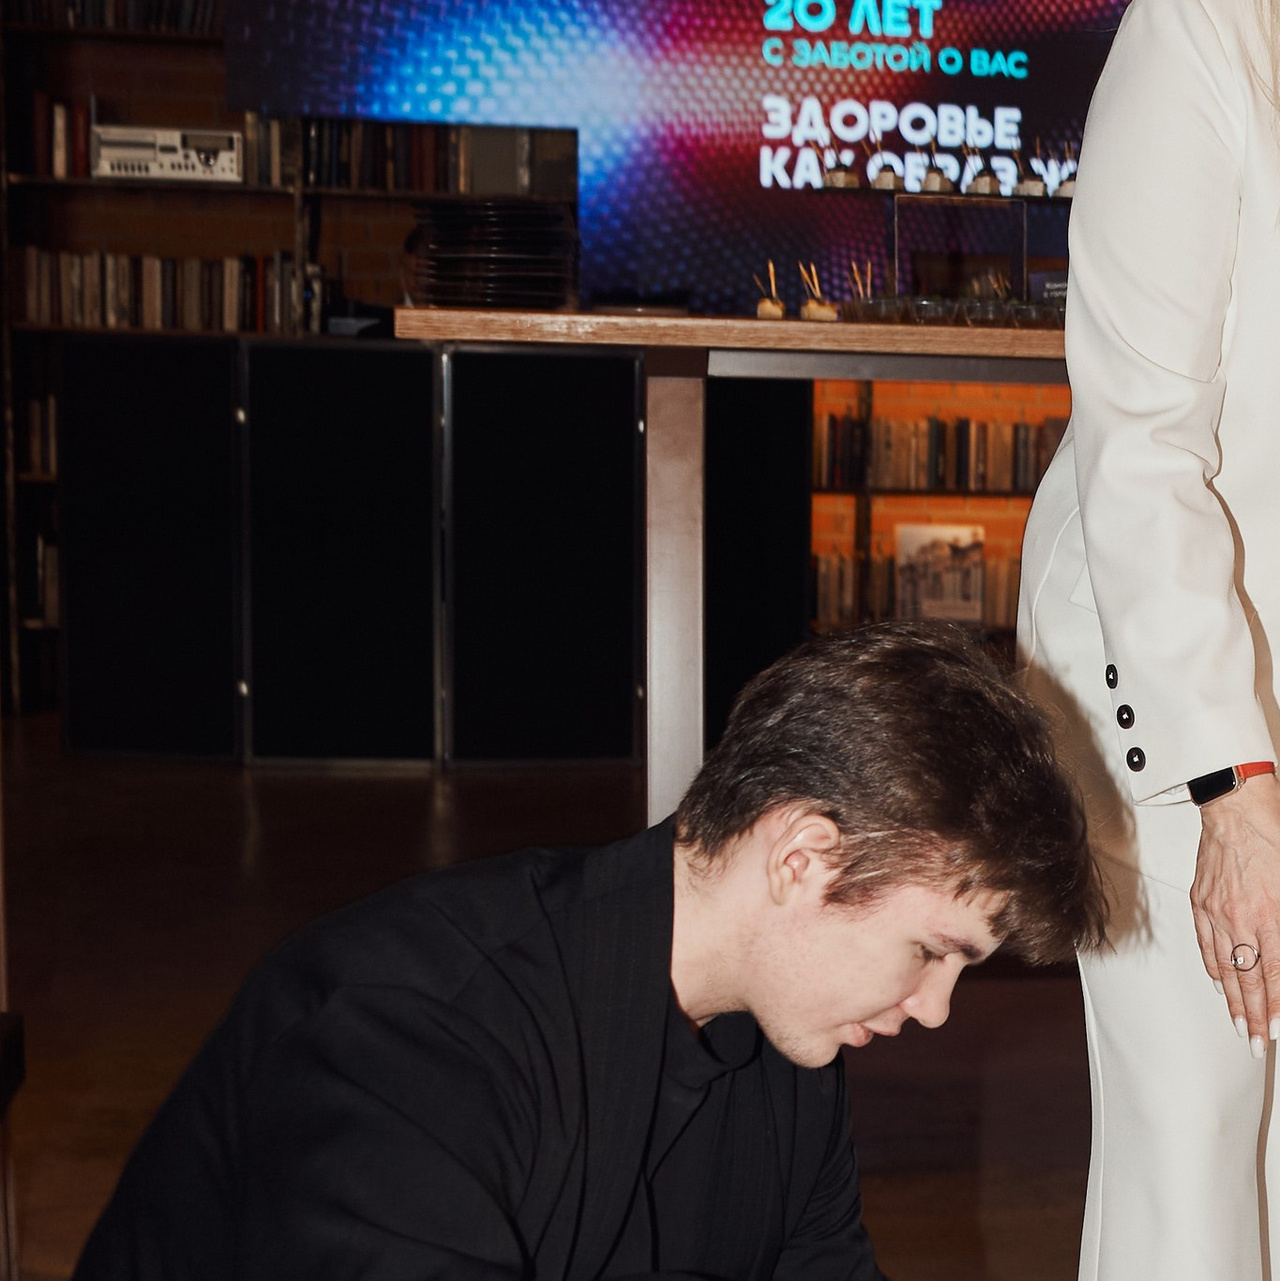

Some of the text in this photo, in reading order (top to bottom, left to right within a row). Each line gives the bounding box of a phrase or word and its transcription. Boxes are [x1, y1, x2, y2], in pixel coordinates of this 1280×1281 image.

[761, 37, 1029, 80] С ЗАБОТОЙ О ВАС
[760, 94, 1023, 151] ЗДОРОВЬЕ
